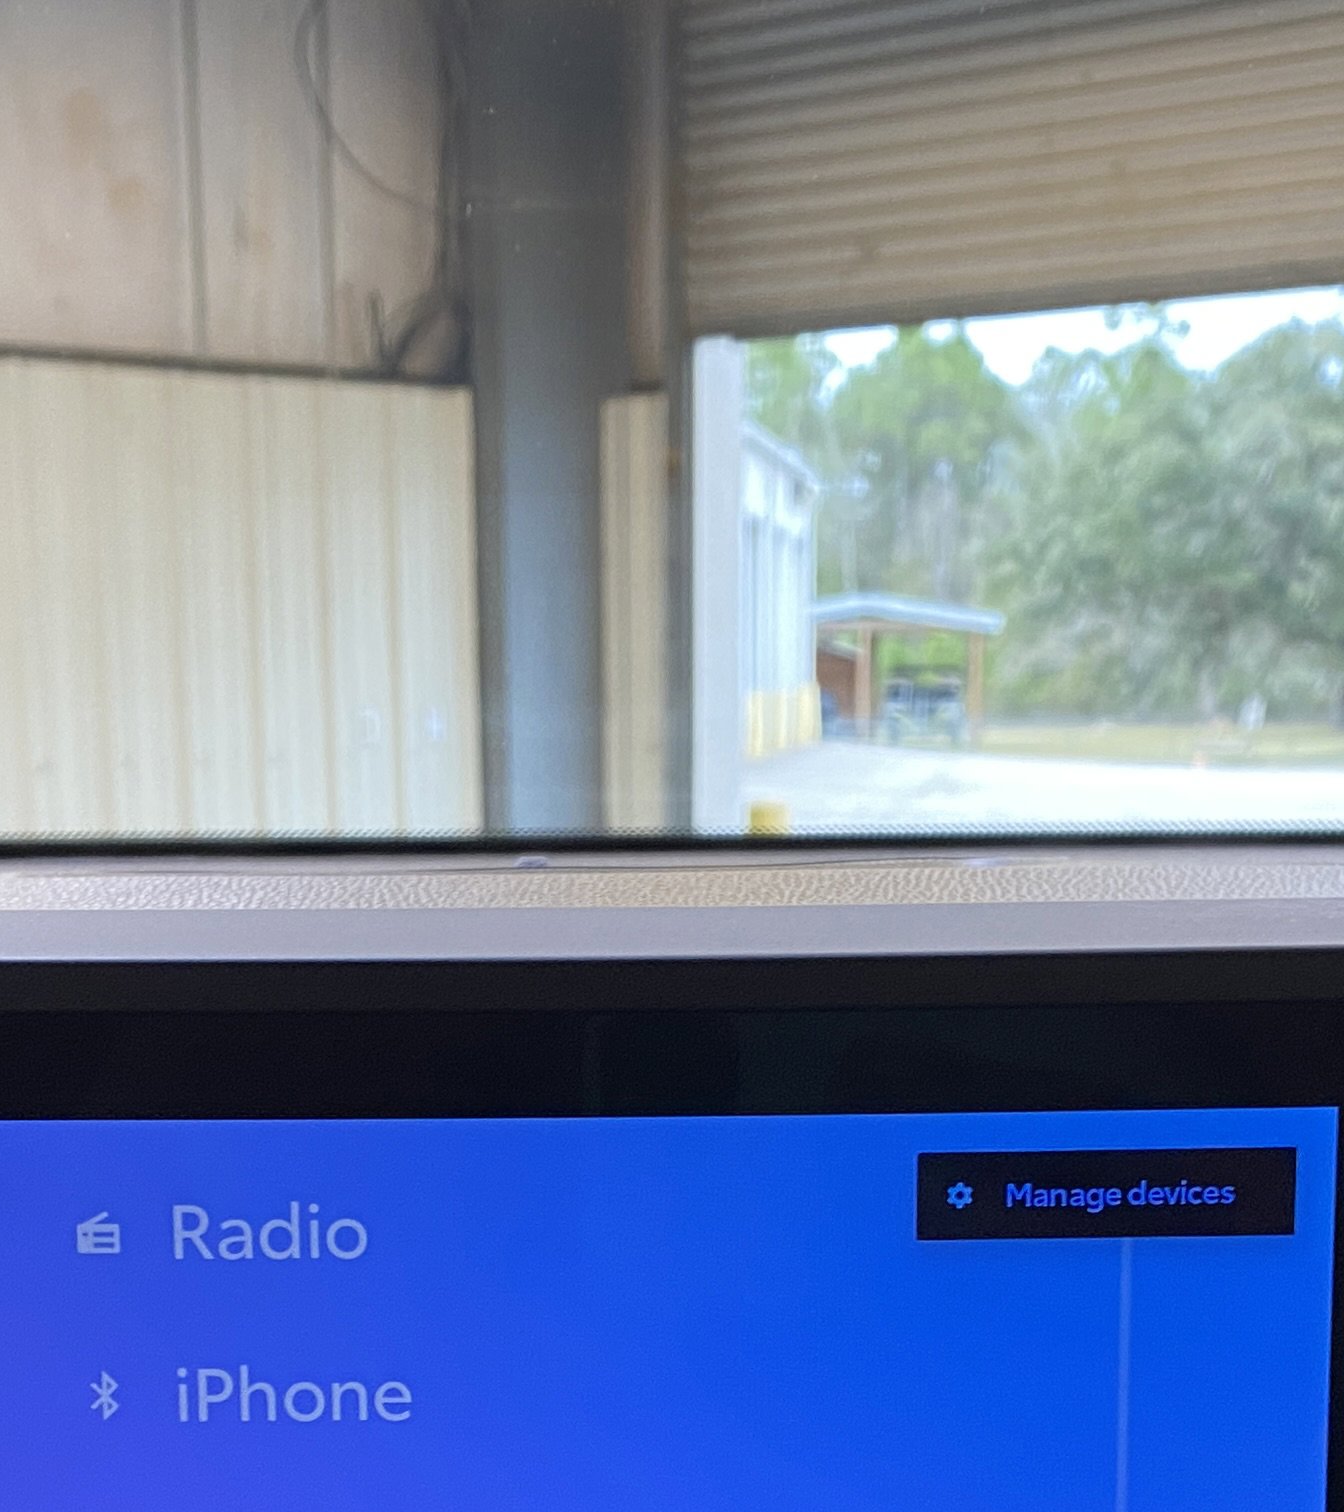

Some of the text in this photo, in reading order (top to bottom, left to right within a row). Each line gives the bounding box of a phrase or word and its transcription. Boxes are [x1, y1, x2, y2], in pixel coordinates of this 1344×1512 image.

[1004, 1179, 1236, 1213] Manage devices
[171, 1201, 368, 1260] Radio
[176, 1364, 413, 1423] iPhone
